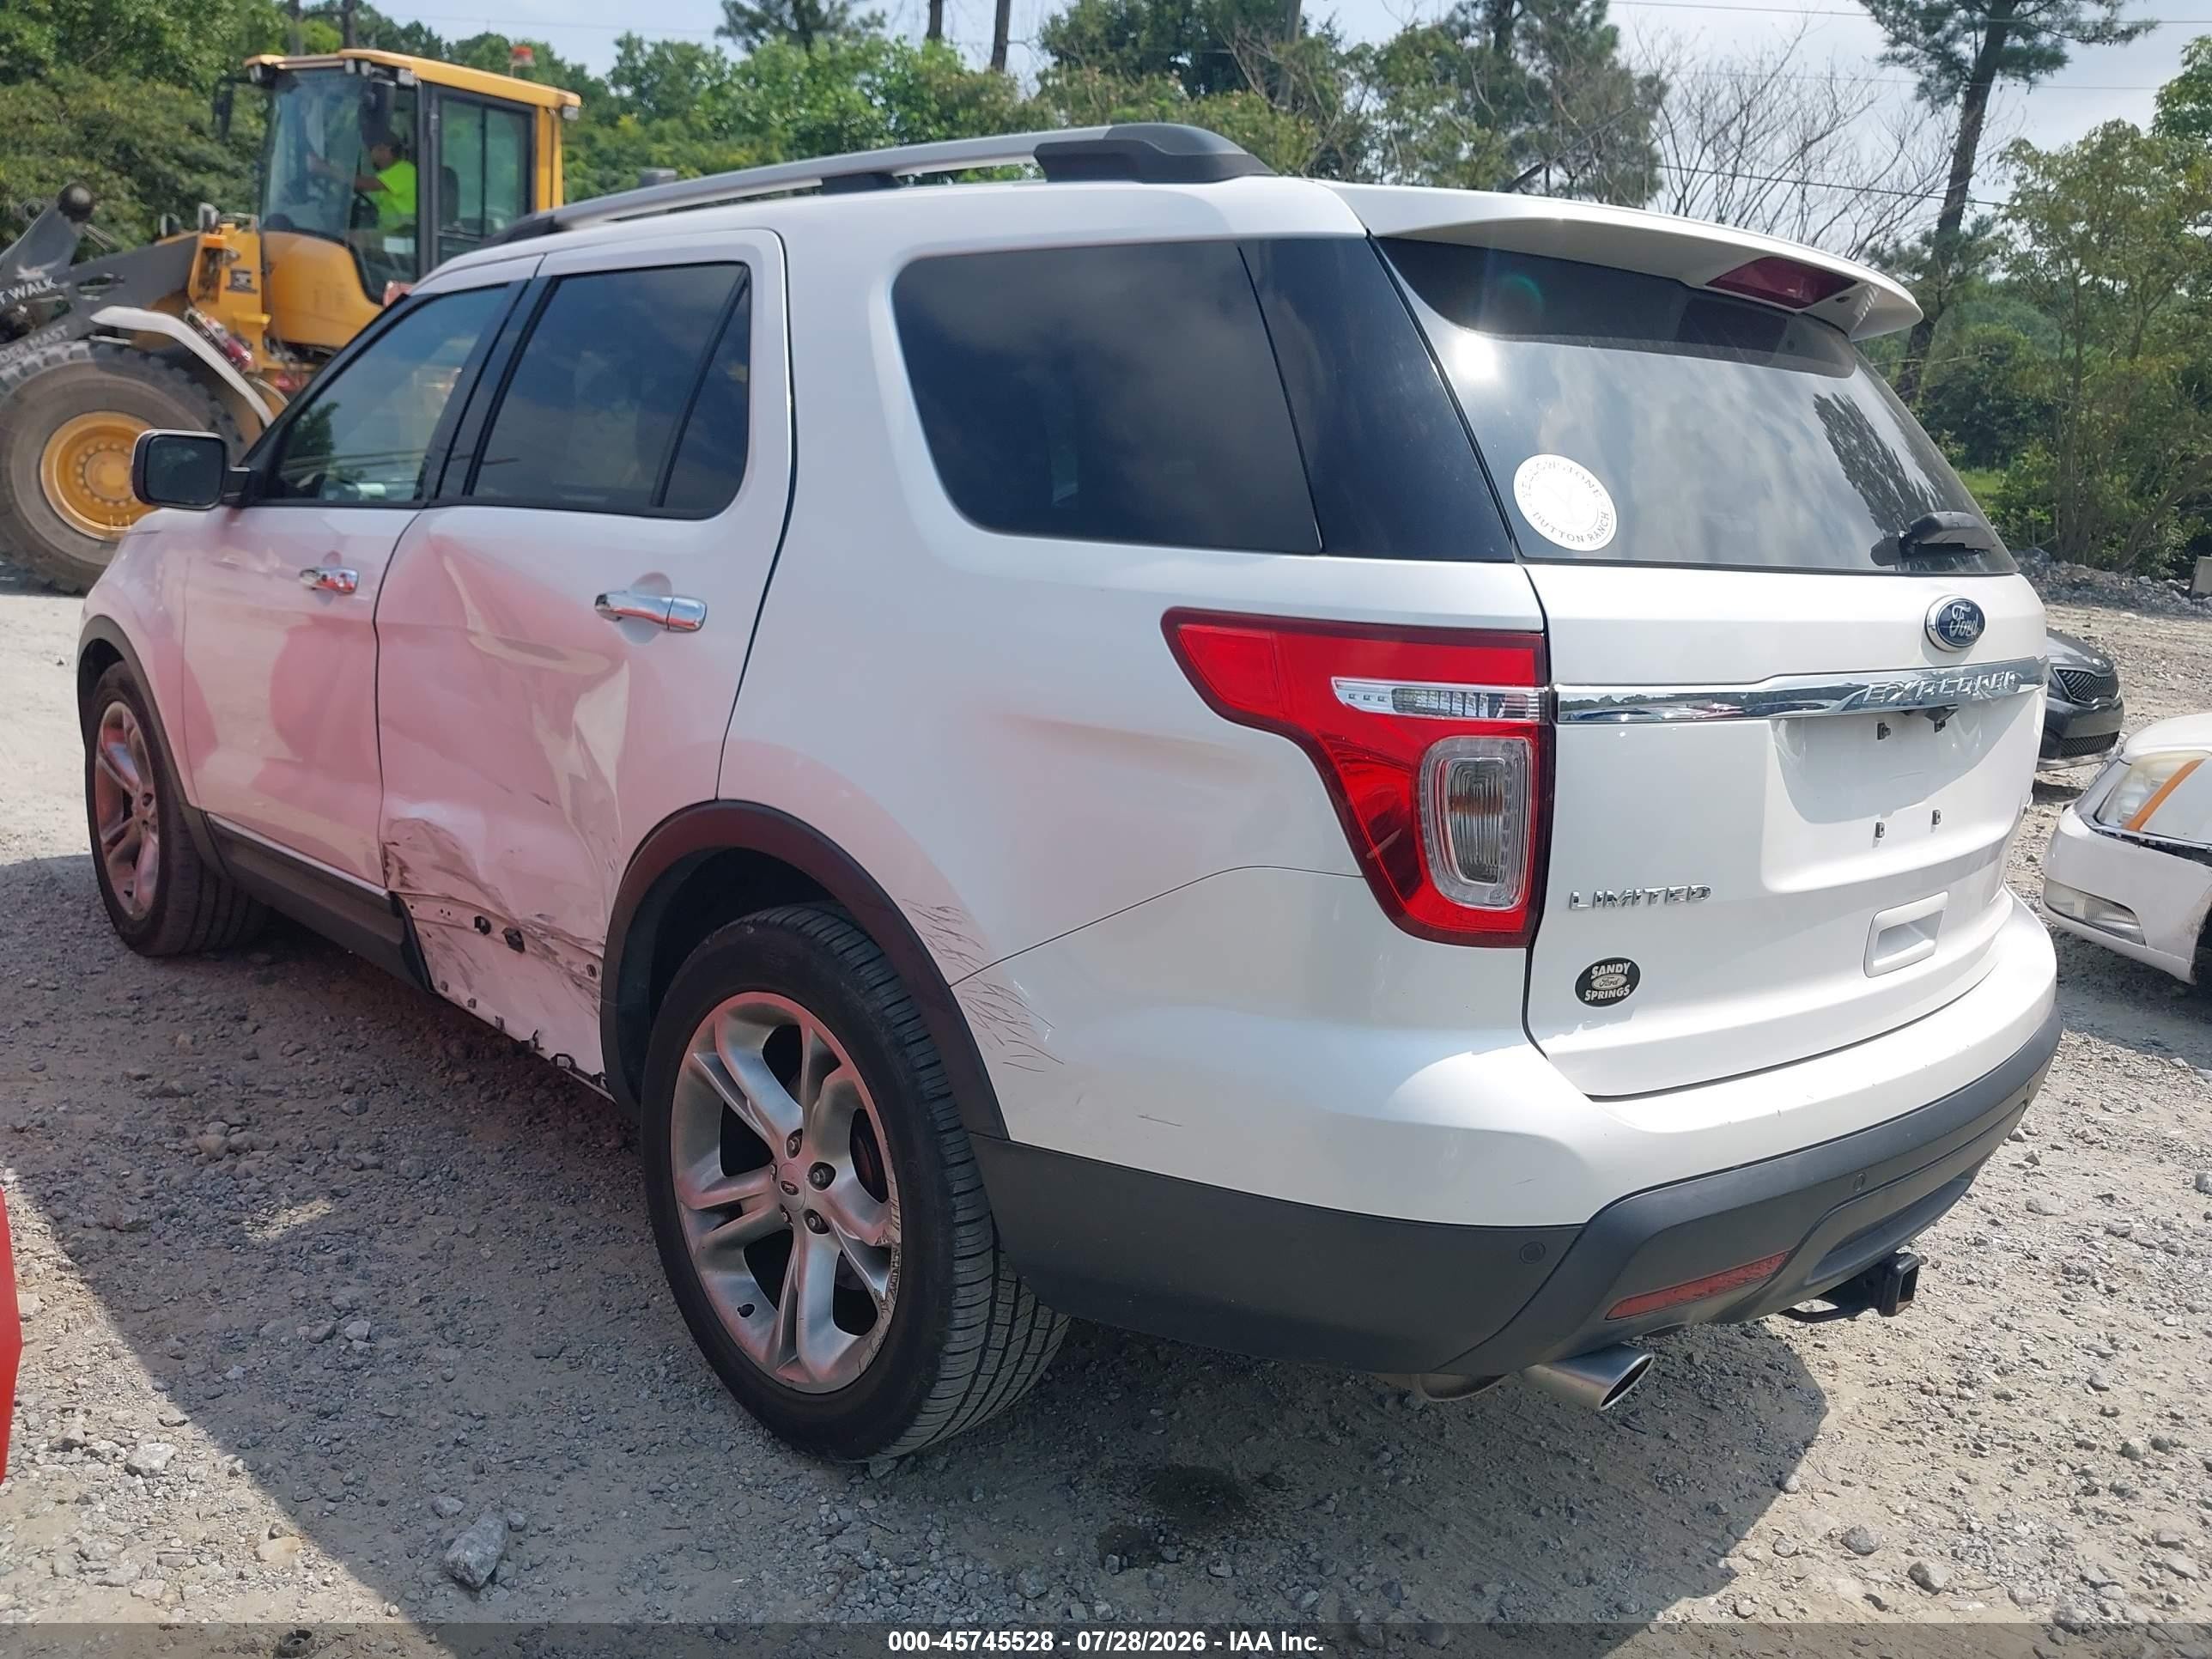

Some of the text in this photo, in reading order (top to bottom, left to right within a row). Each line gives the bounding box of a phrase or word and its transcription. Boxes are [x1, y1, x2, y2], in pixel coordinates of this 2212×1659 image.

[8, 276, 58, 301] WALK
[1532, 510, 1610, 544] DUTTON RANCH
[1948, 605, 1978, 637] Ford
[1569, 883, 1712, 910] LIMITED
[1590, 961, 1632, 980] SANDY
[1599, 975, 1620, 988] Ford
[1584, 985, 1631, 1001] SPRINGS
